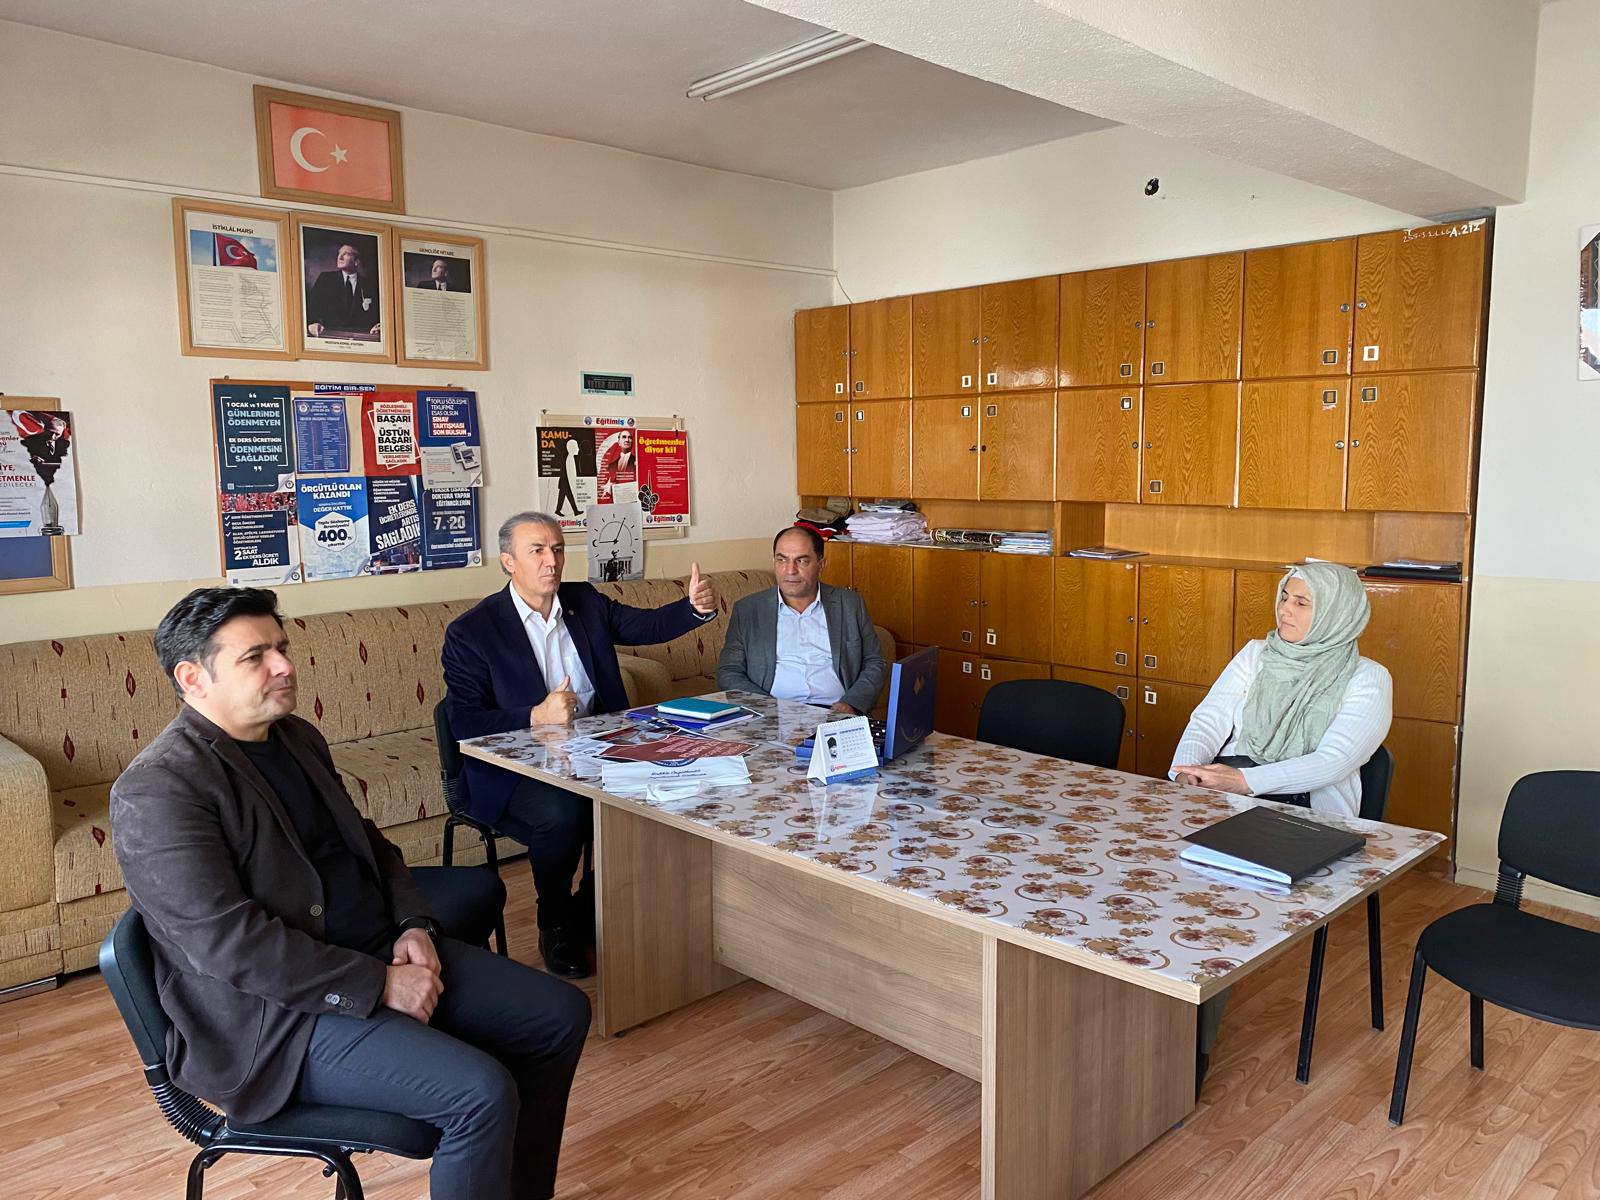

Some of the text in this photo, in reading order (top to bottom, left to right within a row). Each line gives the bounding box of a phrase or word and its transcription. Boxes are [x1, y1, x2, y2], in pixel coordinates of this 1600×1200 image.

[227, 408, 280, 417] GÜNLERİNDE
[227, 418, 281, 426] ÖDENMEYEN
[377, 415, 411, 423] BAŞARI
[379, 427, 410, 436] ÜSTÜN
[378, 436, 412, 444] BAŞARI
[541, 440, 556, 448] DA
[230, 444, 283, 453] ÖDENMESİNİ
[378, 444, 412, 452] BELGESİ
[235, 453, 279, 462] SAĞLADIK
[301, 482, 338, 493] ÖRGÜTLÜ
[338, 483, 362, 491] OLAN
[313, 491, 350, 500] KAZANDI
[318, 528, 348, 542] 400
[234, 550, 243, 560] 2
[252, 558, 279, 566] ALDIK
